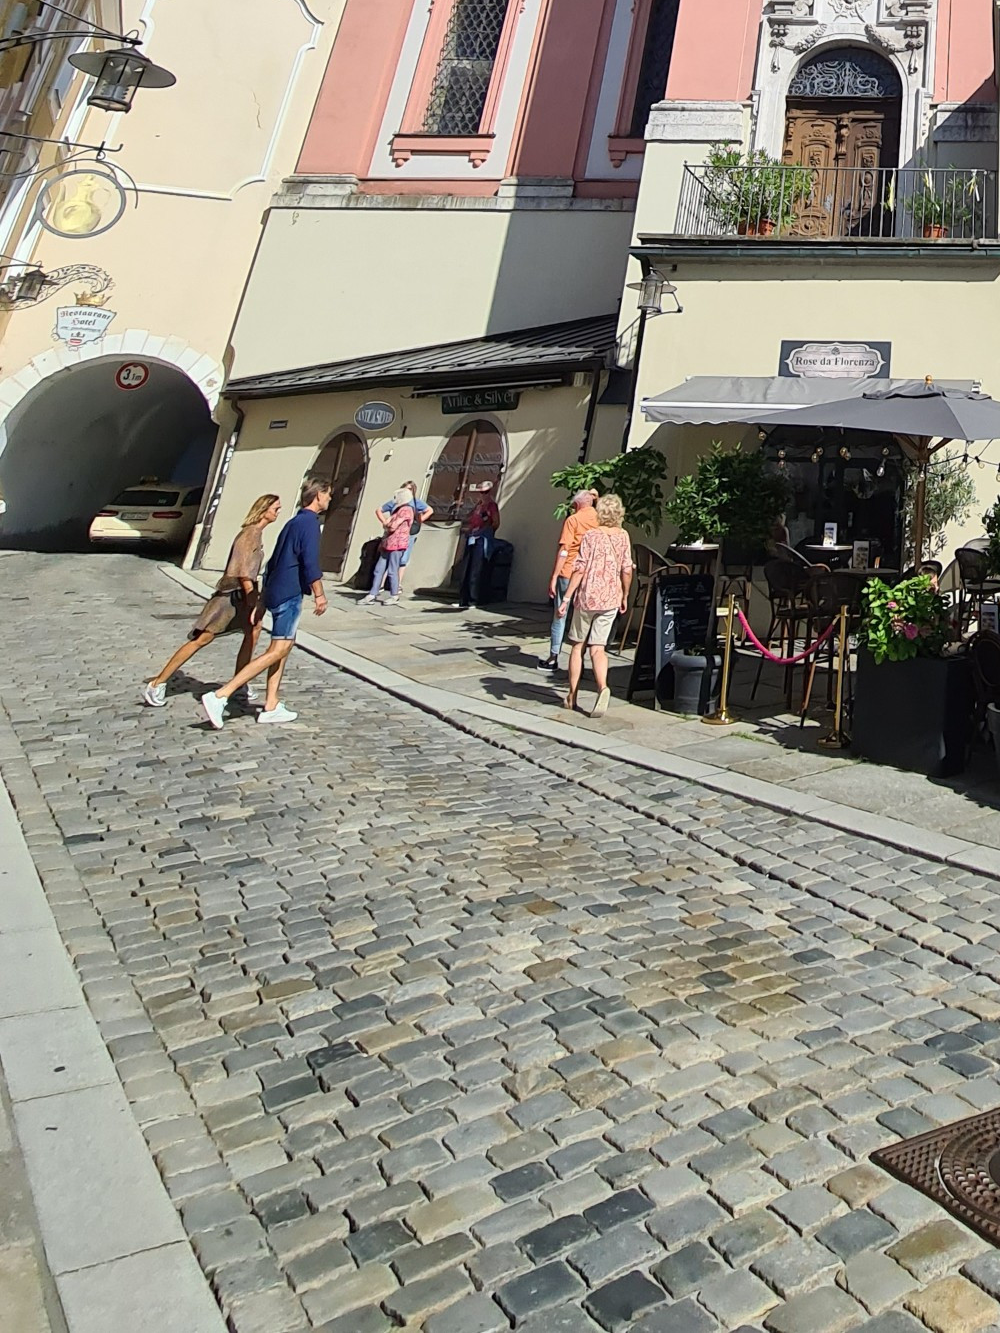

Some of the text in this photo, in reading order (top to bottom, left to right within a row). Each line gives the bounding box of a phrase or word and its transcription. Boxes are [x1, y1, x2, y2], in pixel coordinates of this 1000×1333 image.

[60, 310, 111, 320] Restaurant
[71, 317, 97, 326] Hotel
[795, 356, 875, 367] Rose da Florenza
[474, 393, 482, 405] &
[484, 389, 515, 405] Silver
